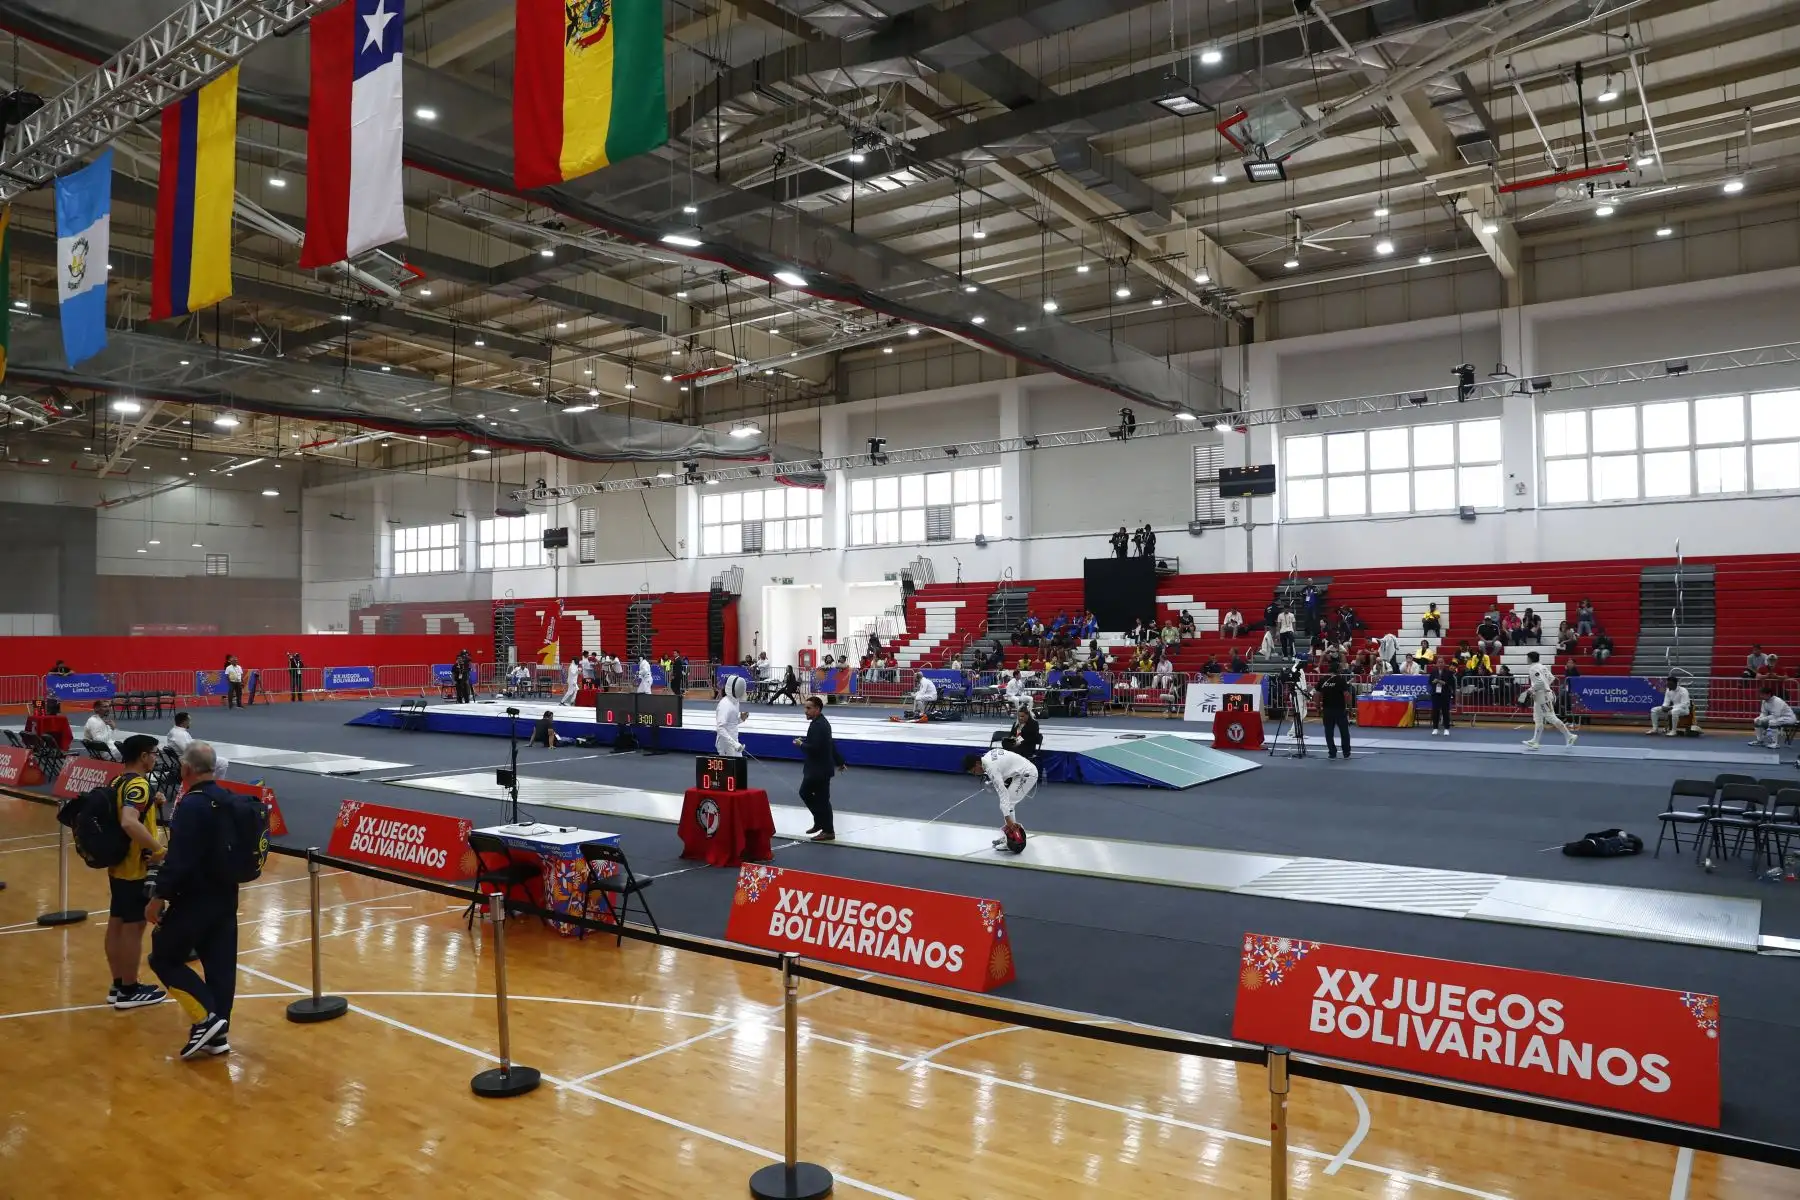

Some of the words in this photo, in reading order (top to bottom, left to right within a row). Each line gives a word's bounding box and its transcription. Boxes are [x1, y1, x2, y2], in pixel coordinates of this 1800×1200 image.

[55, 681, 90, 690] Ayacucho
[1394, 684, 1427, 692] JUEGOS
[1582, 687, 1628, 696] Ayacucho
[1604, 694, 1653, 704] Lima2025
[1201, 704, 1217, 713] FIE
[1227, 703, 1233, 712] 0
[1243, 703, 1249, 712] 0
[607, 710, 613, 722] 0
[639, 714, 653, 725] 3:00
[666, 713, 673, 726] 0
[707, 759, 723, 771] 3:00
[69, 766, 83, 780] XX
[80, 768, 108, 784] JUEGOS
[703, 774, 710, 789] 0
[727, 776, 734, 791] 0
[65, 778, 107, 794] BOLIVAR
[355, 815, 377, 836] XX
[374, 820, 427, 845] JUEGOS
[349, 832, 448, 869] BOLIVARIANOS
[774, 887, 813, 917] XX
[812, 894, 914, 935] JUEGOS
[768, 911, 965, 973] BOLIVARIANOS
[1313, 965, 1379, 1007] XX
[1380, 976, 1565, 1036] JUEGOS
[1308, 999, 1672, 1094] BOLIVARIANOS
